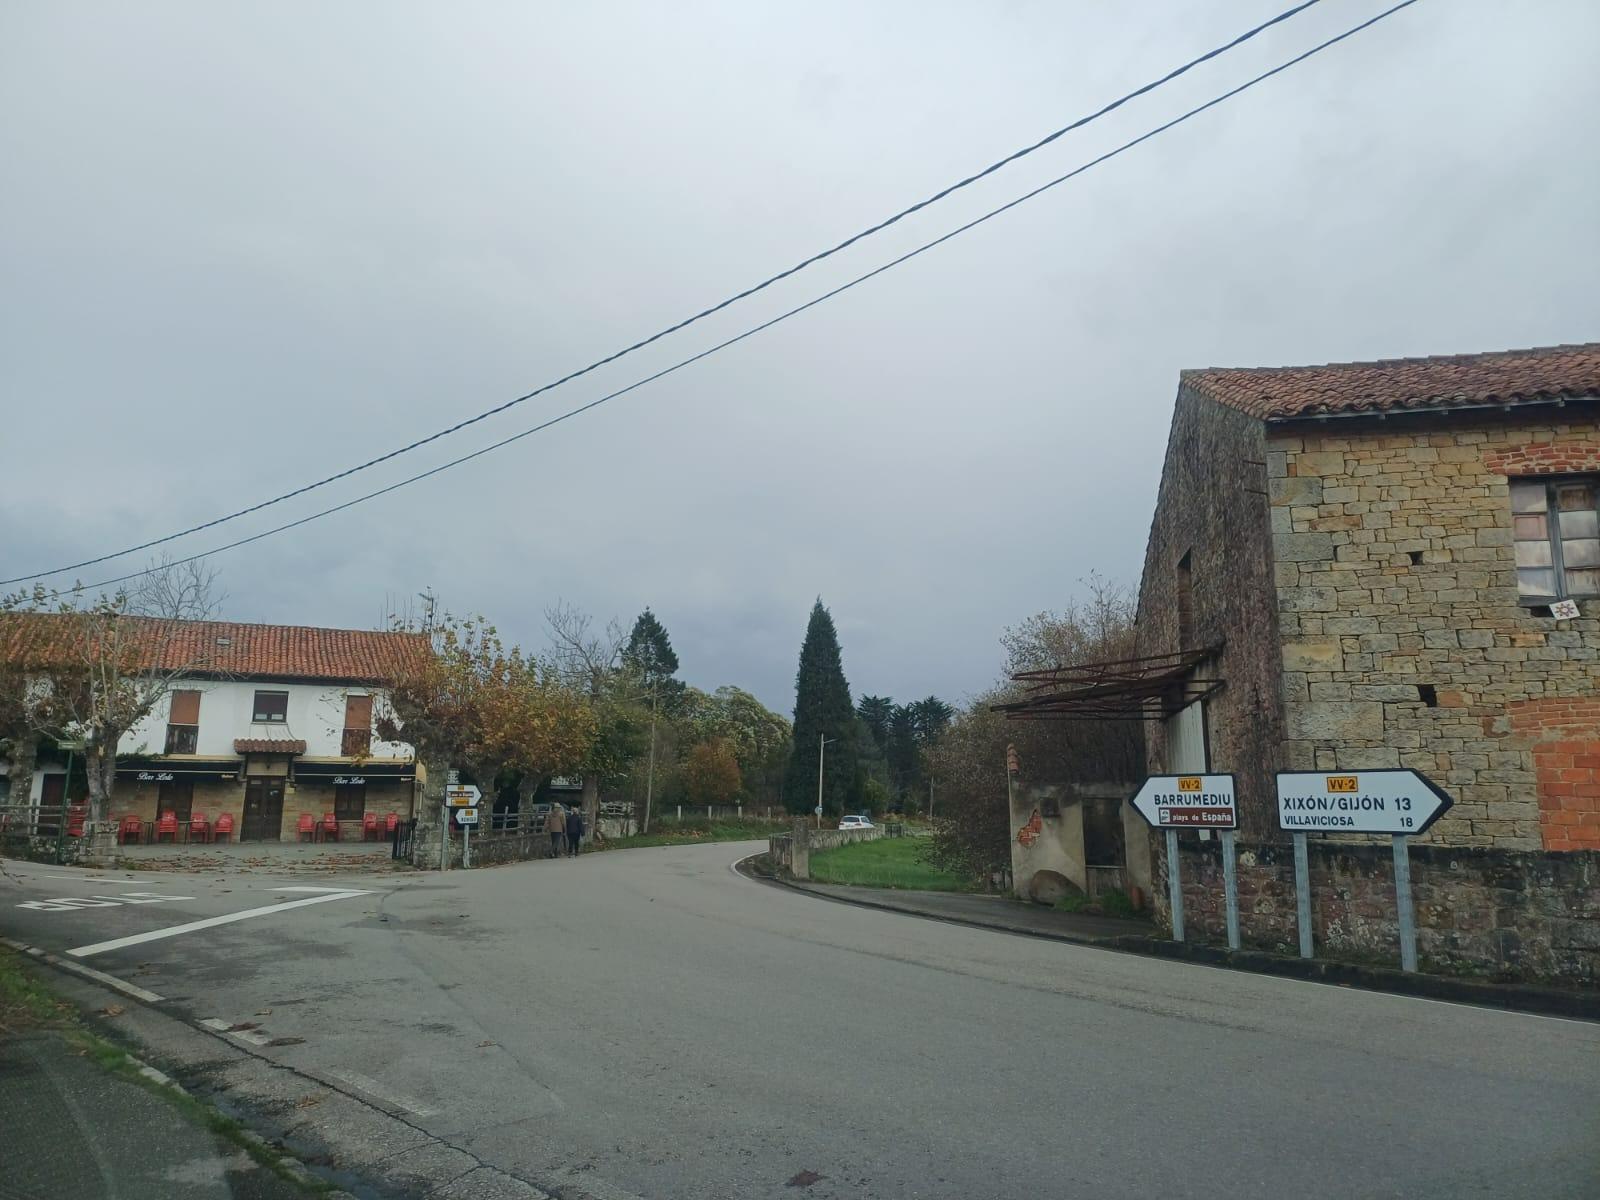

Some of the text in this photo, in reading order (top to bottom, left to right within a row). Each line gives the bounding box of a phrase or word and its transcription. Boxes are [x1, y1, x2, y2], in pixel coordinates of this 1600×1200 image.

[137, 772, 154, 780] Bar
[333, 776, 348, 784] Bar
[1180, 780, 1200, 789] VV-2
[1330, 779, 1356, 790] VV-2
[1154, 794, 1231, 806] BARRUMEDIU
[1283, 795, 1412, 811] XIXÓN/GIJÓN 13
[1202, 812, 1232, 823] España
[1284, 816, 1413, 828] VILLAVICIOSA 18
